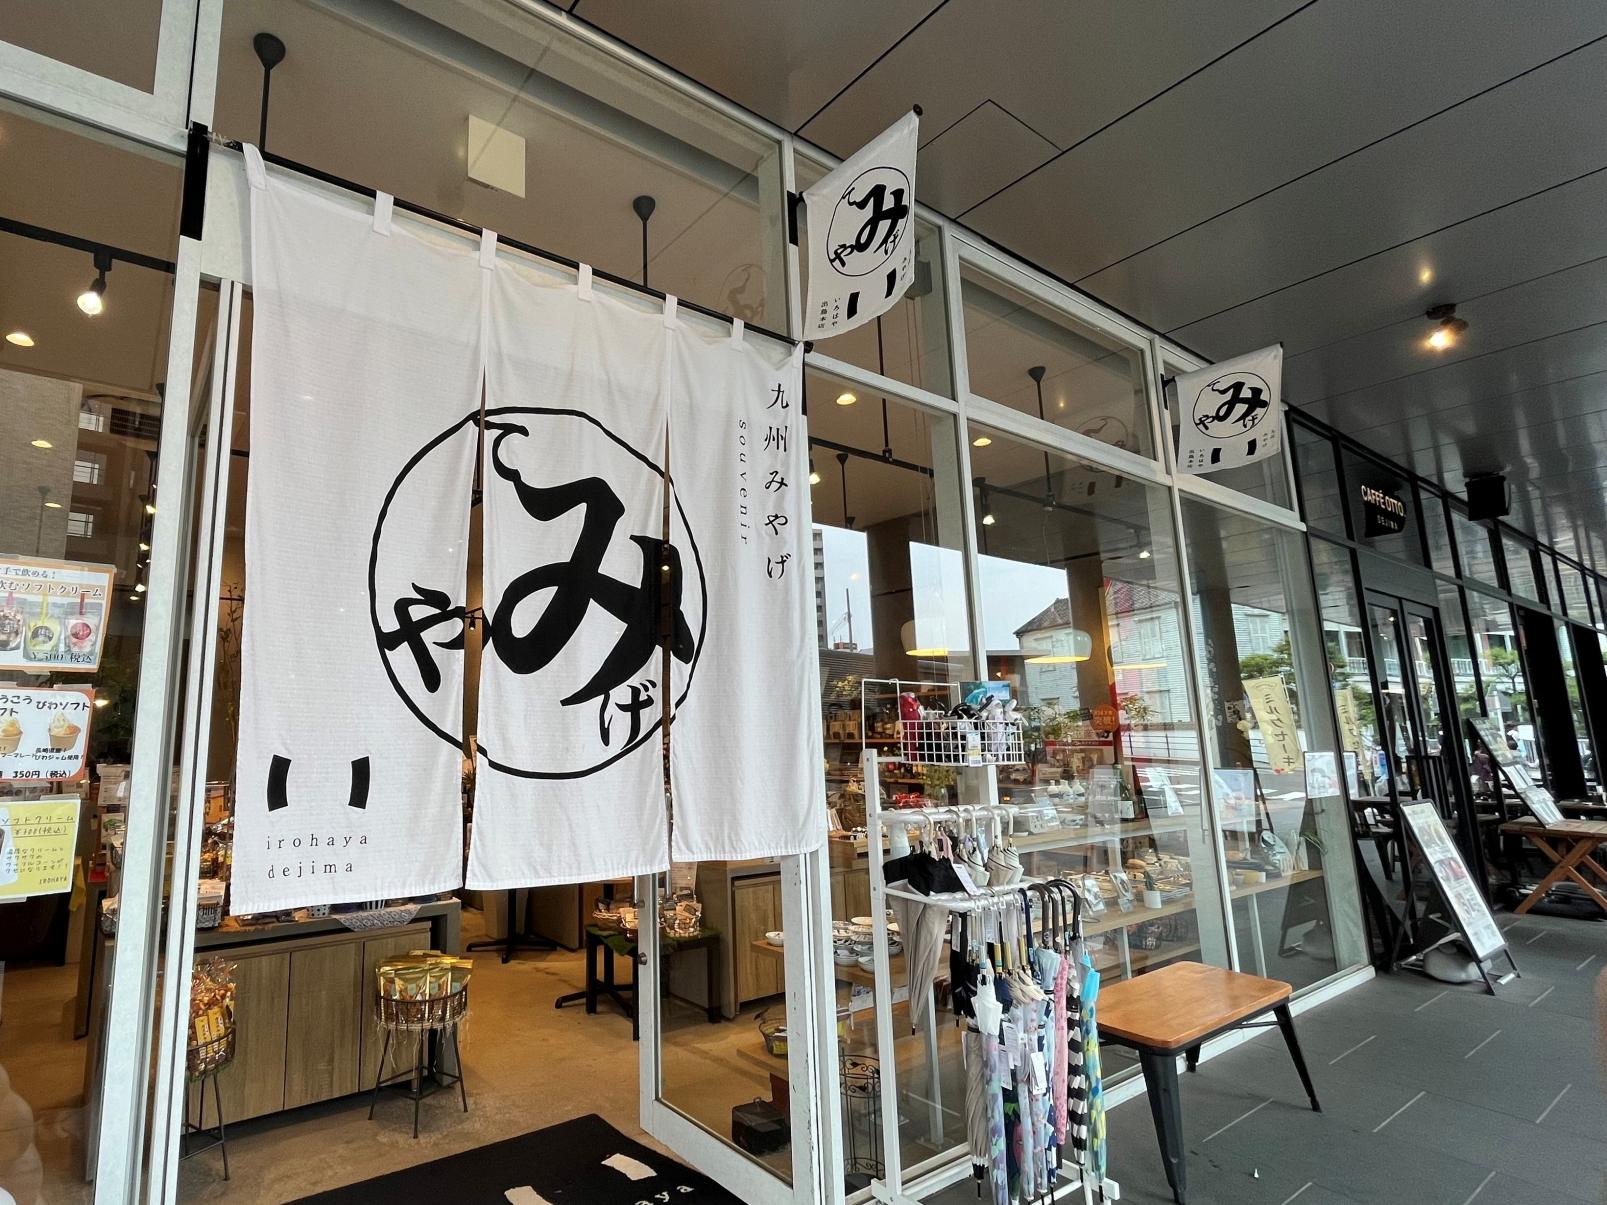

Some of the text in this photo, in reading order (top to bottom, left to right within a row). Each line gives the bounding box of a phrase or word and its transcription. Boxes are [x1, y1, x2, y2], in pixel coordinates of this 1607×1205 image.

[739, 419, 750, 545] souvenir
[764, 383, 791, 580] 九州みやげ
[36, 701, 90, 711] びわソフト
[266, 833, 368, 850] irohaya
[267, 860, 353, 879] dejima
